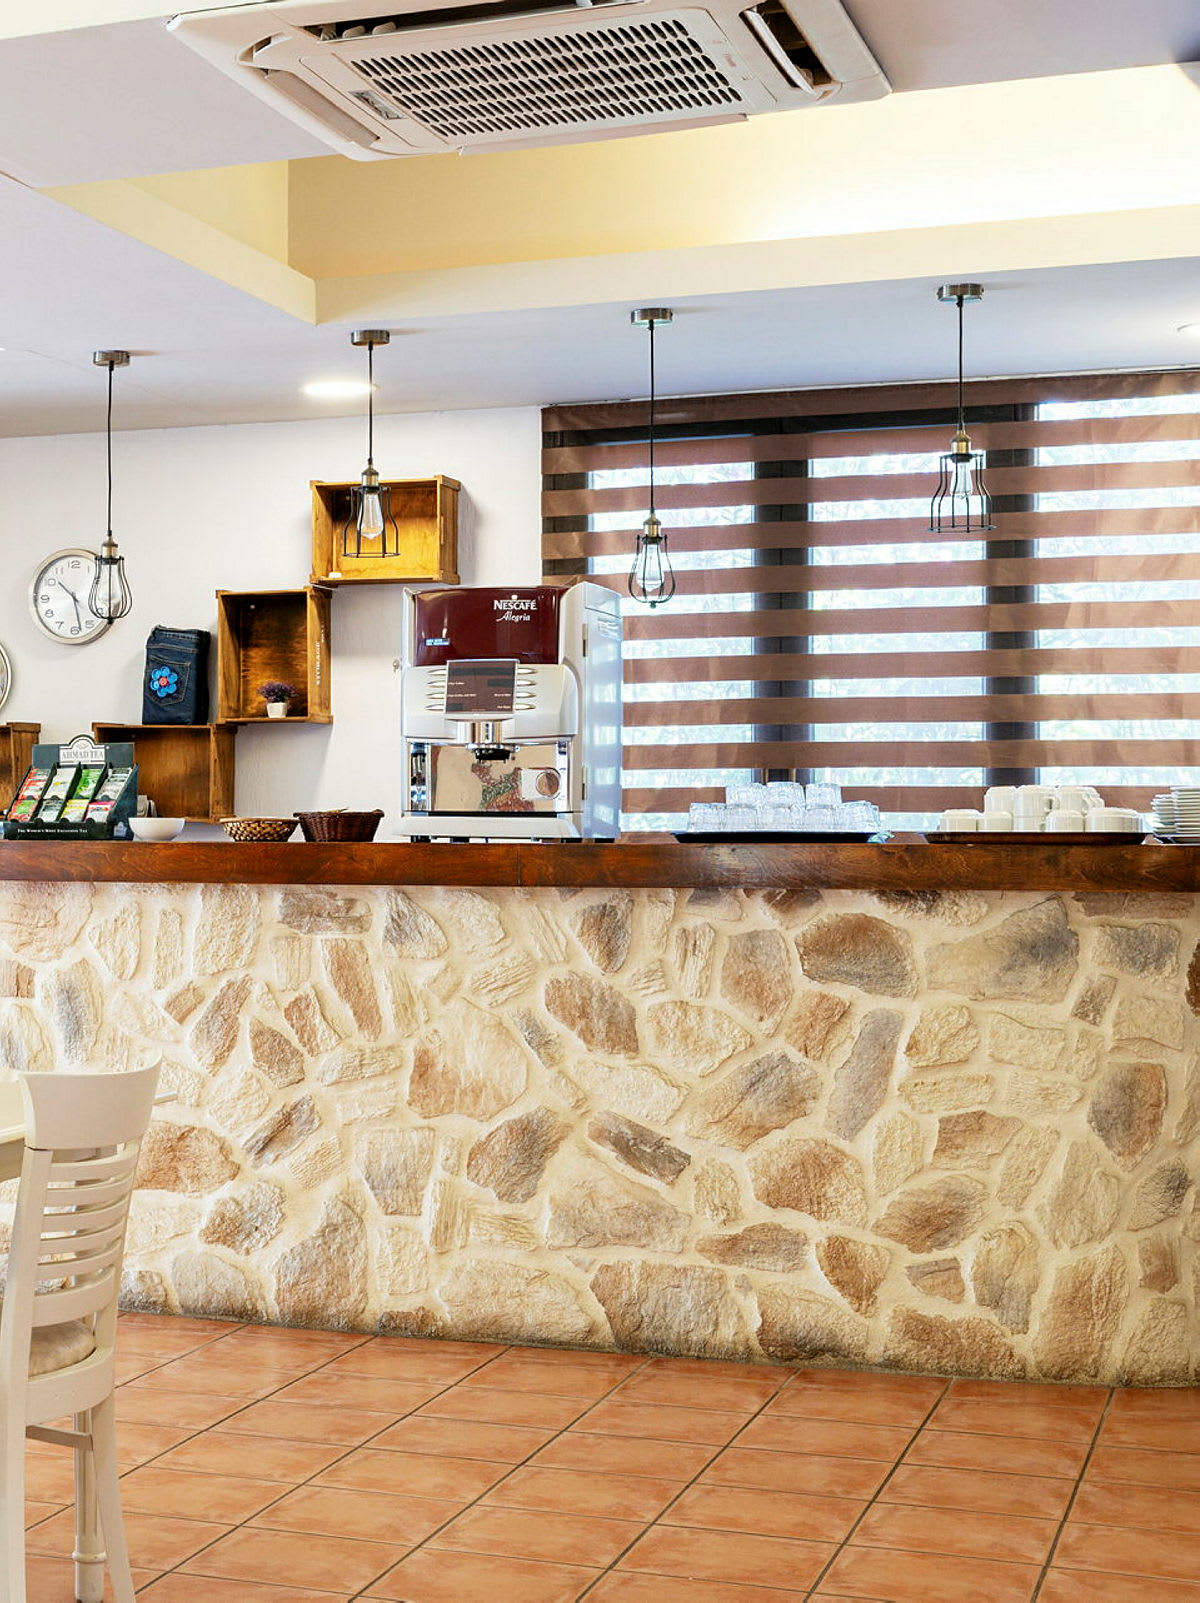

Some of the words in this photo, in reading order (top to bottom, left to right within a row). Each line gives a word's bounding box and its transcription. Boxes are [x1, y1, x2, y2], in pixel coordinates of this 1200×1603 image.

[67, 560, 81, 569] 12
[55, 567, 65, 575] 11
[44, 578, 57, 587] 10
[40, 594, 50, 603] 9
[493, 599, 538, 610] NESCAFÉ
[45, 608, 55, 618] 8
[495, 610, 531, 622] Alegria
[55, 621, 65, 630] 7
[85, 620, 95, 629] 5
[70, 626, 80, 636] 6
[62, 750, 89, 760] AHMAD
[90, 750, 104, 760] TEA
